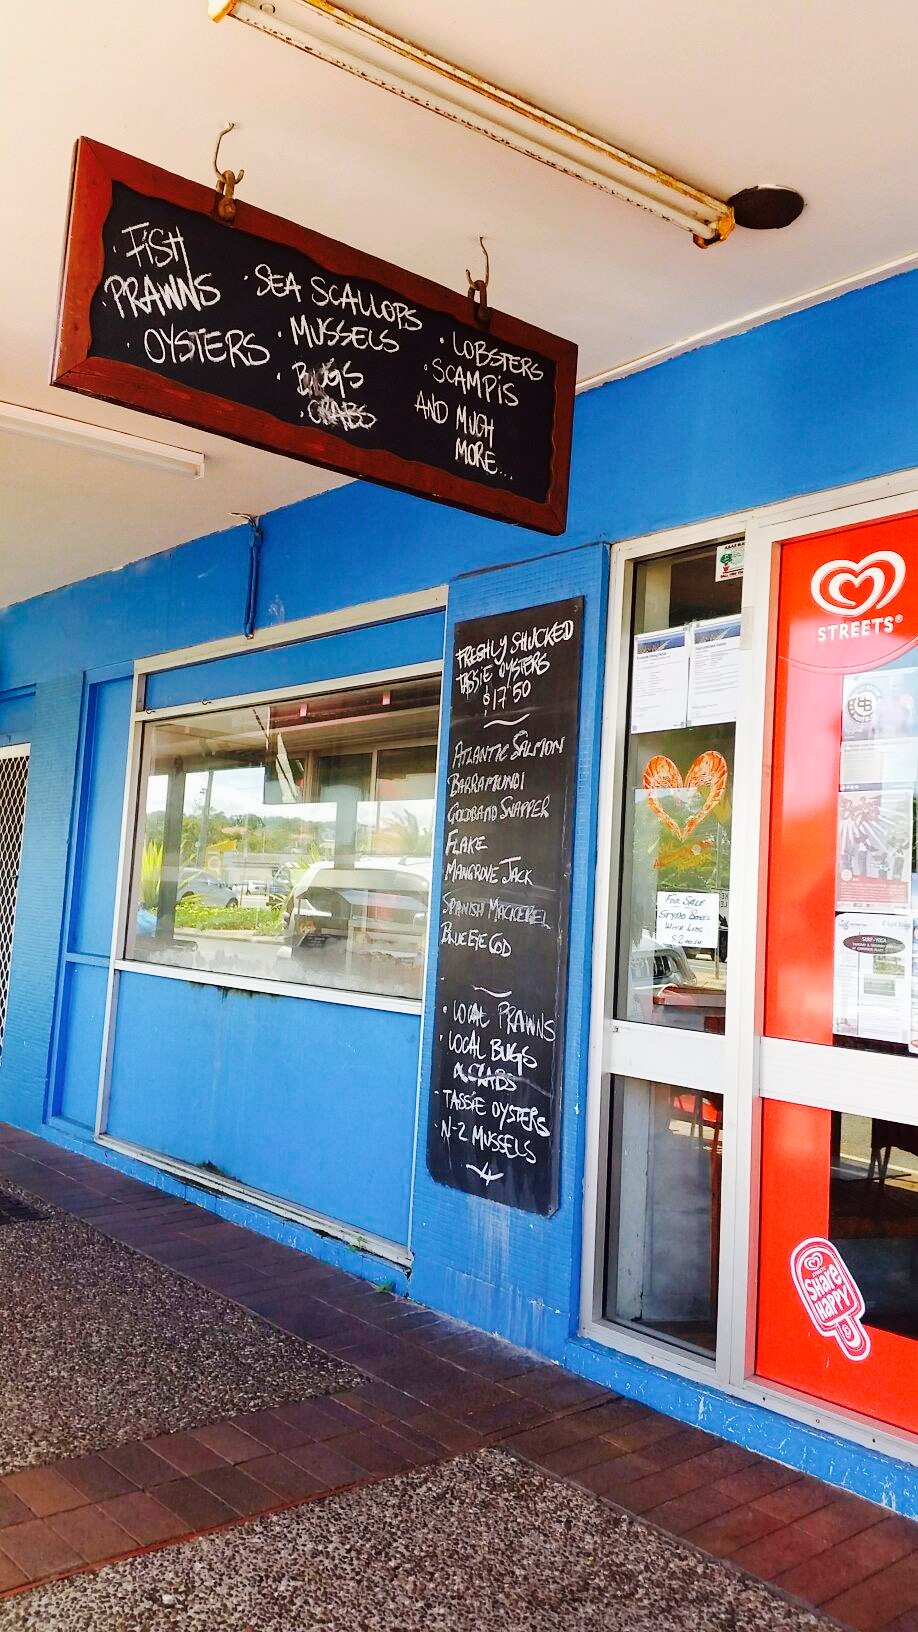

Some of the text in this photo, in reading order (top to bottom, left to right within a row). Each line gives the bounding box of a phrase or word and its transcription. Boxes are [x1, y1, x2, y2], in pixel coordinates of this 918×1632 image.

[122, 222, 190, 268] FISH
[104, 272, 221, 318] PRAWNS
[255, 264, 422, 331] SEA SCALLOPS
[144, 324, 270, 368] OYSTERS
[290, 315, 399, 353] MUSSELS
[453, 331, 544, 381] LOBSTERS
[431, 358, 519, 407] SCAMPIS
[414, 391, 494, 447] AND MUCH
[456, 620, 574, 669] FRESHLY SHUCKED
[456, 651, 550, 697] TASSIE OYSTERS
[452, 730, 566, 769] ATLANTIC SALMON
[447, 771, 526, 798] BARRAMUNDI
[447, 794, 551, 825] GOLDBAND SNAPPER
[445, 829, 488, 857] FLAKE
[445, 856, 534, 886] MANGROVE JACK
[442, 892, 552, 930] SPANISH MACKEREL
[682, 896, 706, 907] SALE
[488, 932, 512, 958] COD
[453, 1001, 556, 1042] LOCAL PRAWNS
[448, 1030, 537, 1076] LOCAL BUGS
[443, 1089, 550, 1137] TASSIE OYSTERS
[472, 1125, 537, 1164] MUSSELS
